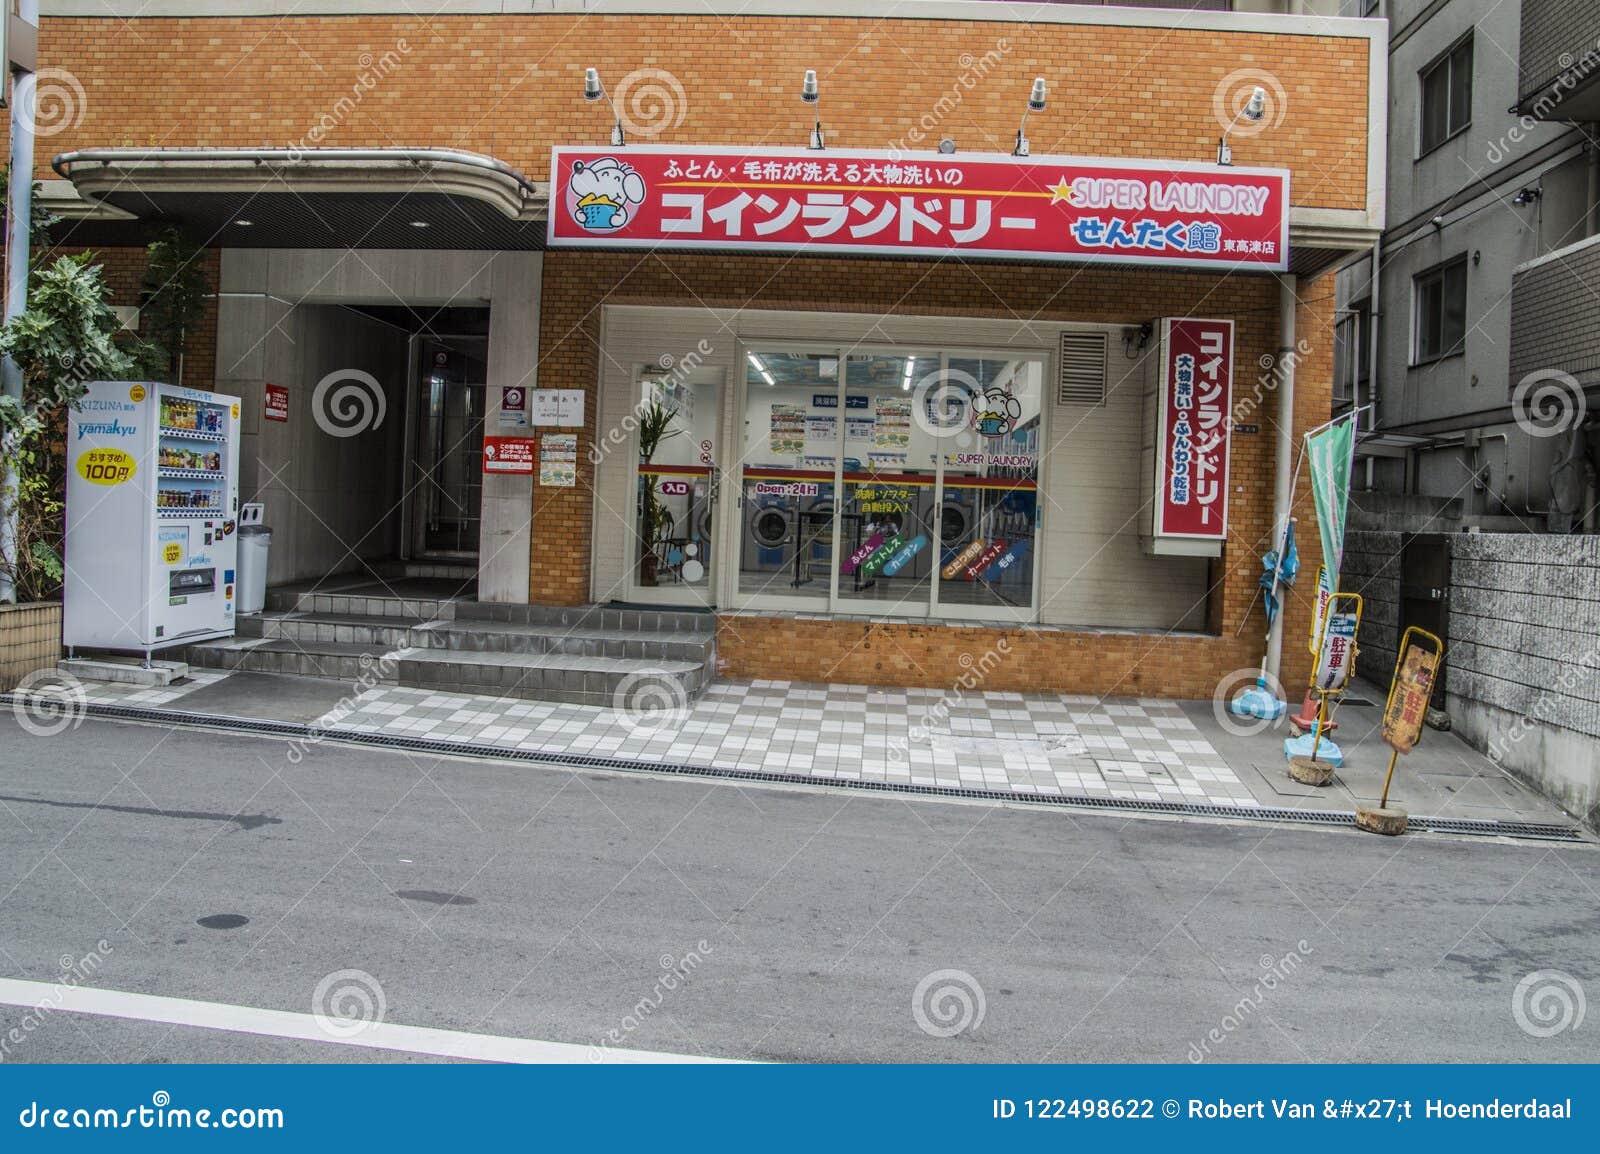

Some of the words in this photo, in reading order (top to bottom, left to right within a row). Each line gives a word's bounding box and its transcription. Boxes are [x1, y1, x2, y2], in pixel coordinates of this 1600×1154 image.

[663, 160, 963, 188] ふとん・毛布が洗える大物洗いの
[1071, 178, 1147, 210] SUPER
[1150, 181, 1271, 216] LAUNDRY
[660, 191, 1036, 244] コインランドリー
[1069, 217, 1221, 252] せんたく館
[1223, 239, 1275, 255] 東高津店
[78, 419, 136, 440] yamakyu
[1171, 353, 1195, 505] 大物洗い・ふんわり乾燥
[1196, 331, 1224, 525] コインランドリー
[957, 454, 984, 465] SUPER
[987, 455, 1034, 466] LAUNDRY
[86, 465, 129, 482] 100円
[664, 483, 688, 493] 入口
[851, 544, 874, 564] ふとん
